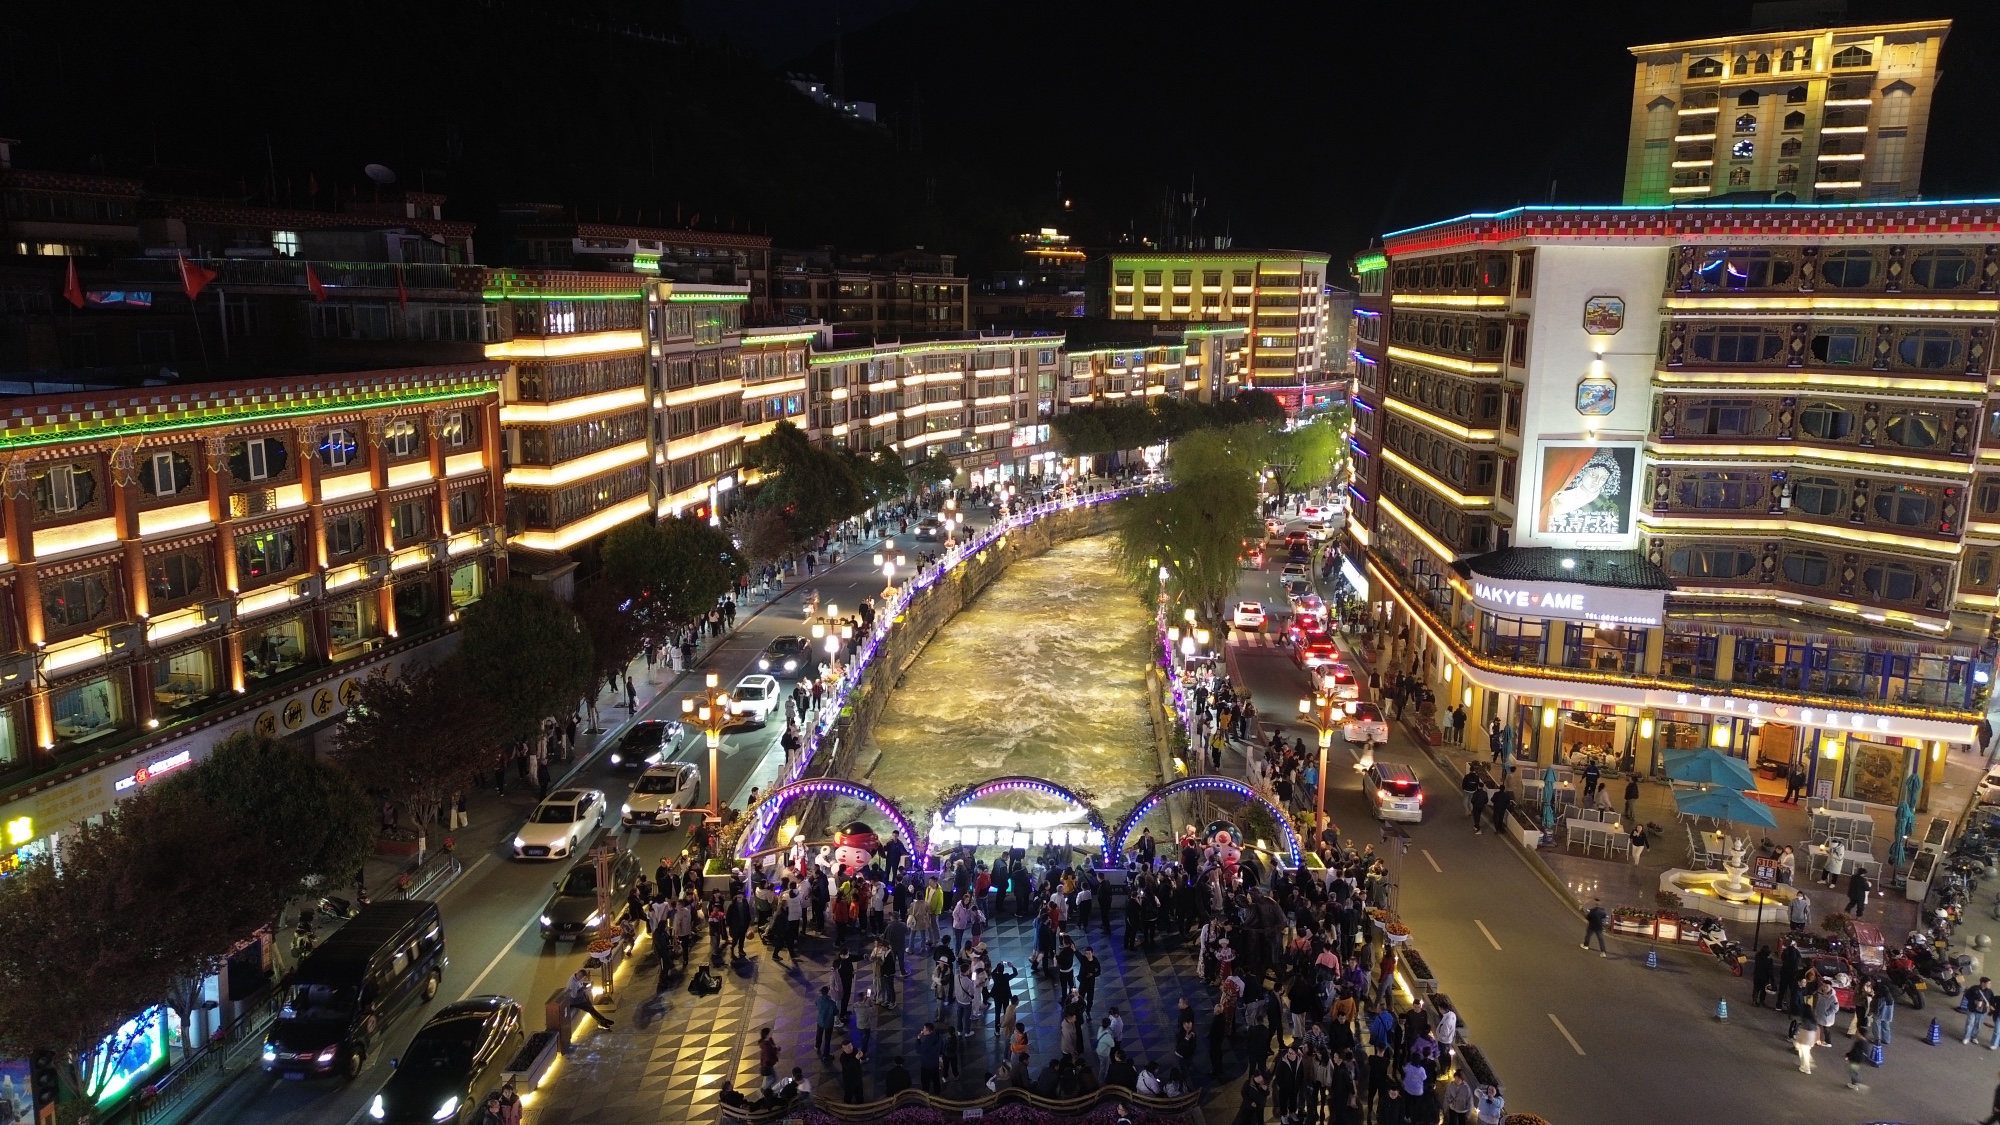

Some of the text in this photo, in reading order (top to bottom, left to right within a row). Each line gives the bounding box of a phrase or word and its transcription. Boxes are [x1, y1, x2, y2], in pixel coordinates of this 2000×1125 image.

[1475, 582, 1584, 611] MAKYE AME
[1757, 858, 1773, 867] 318
